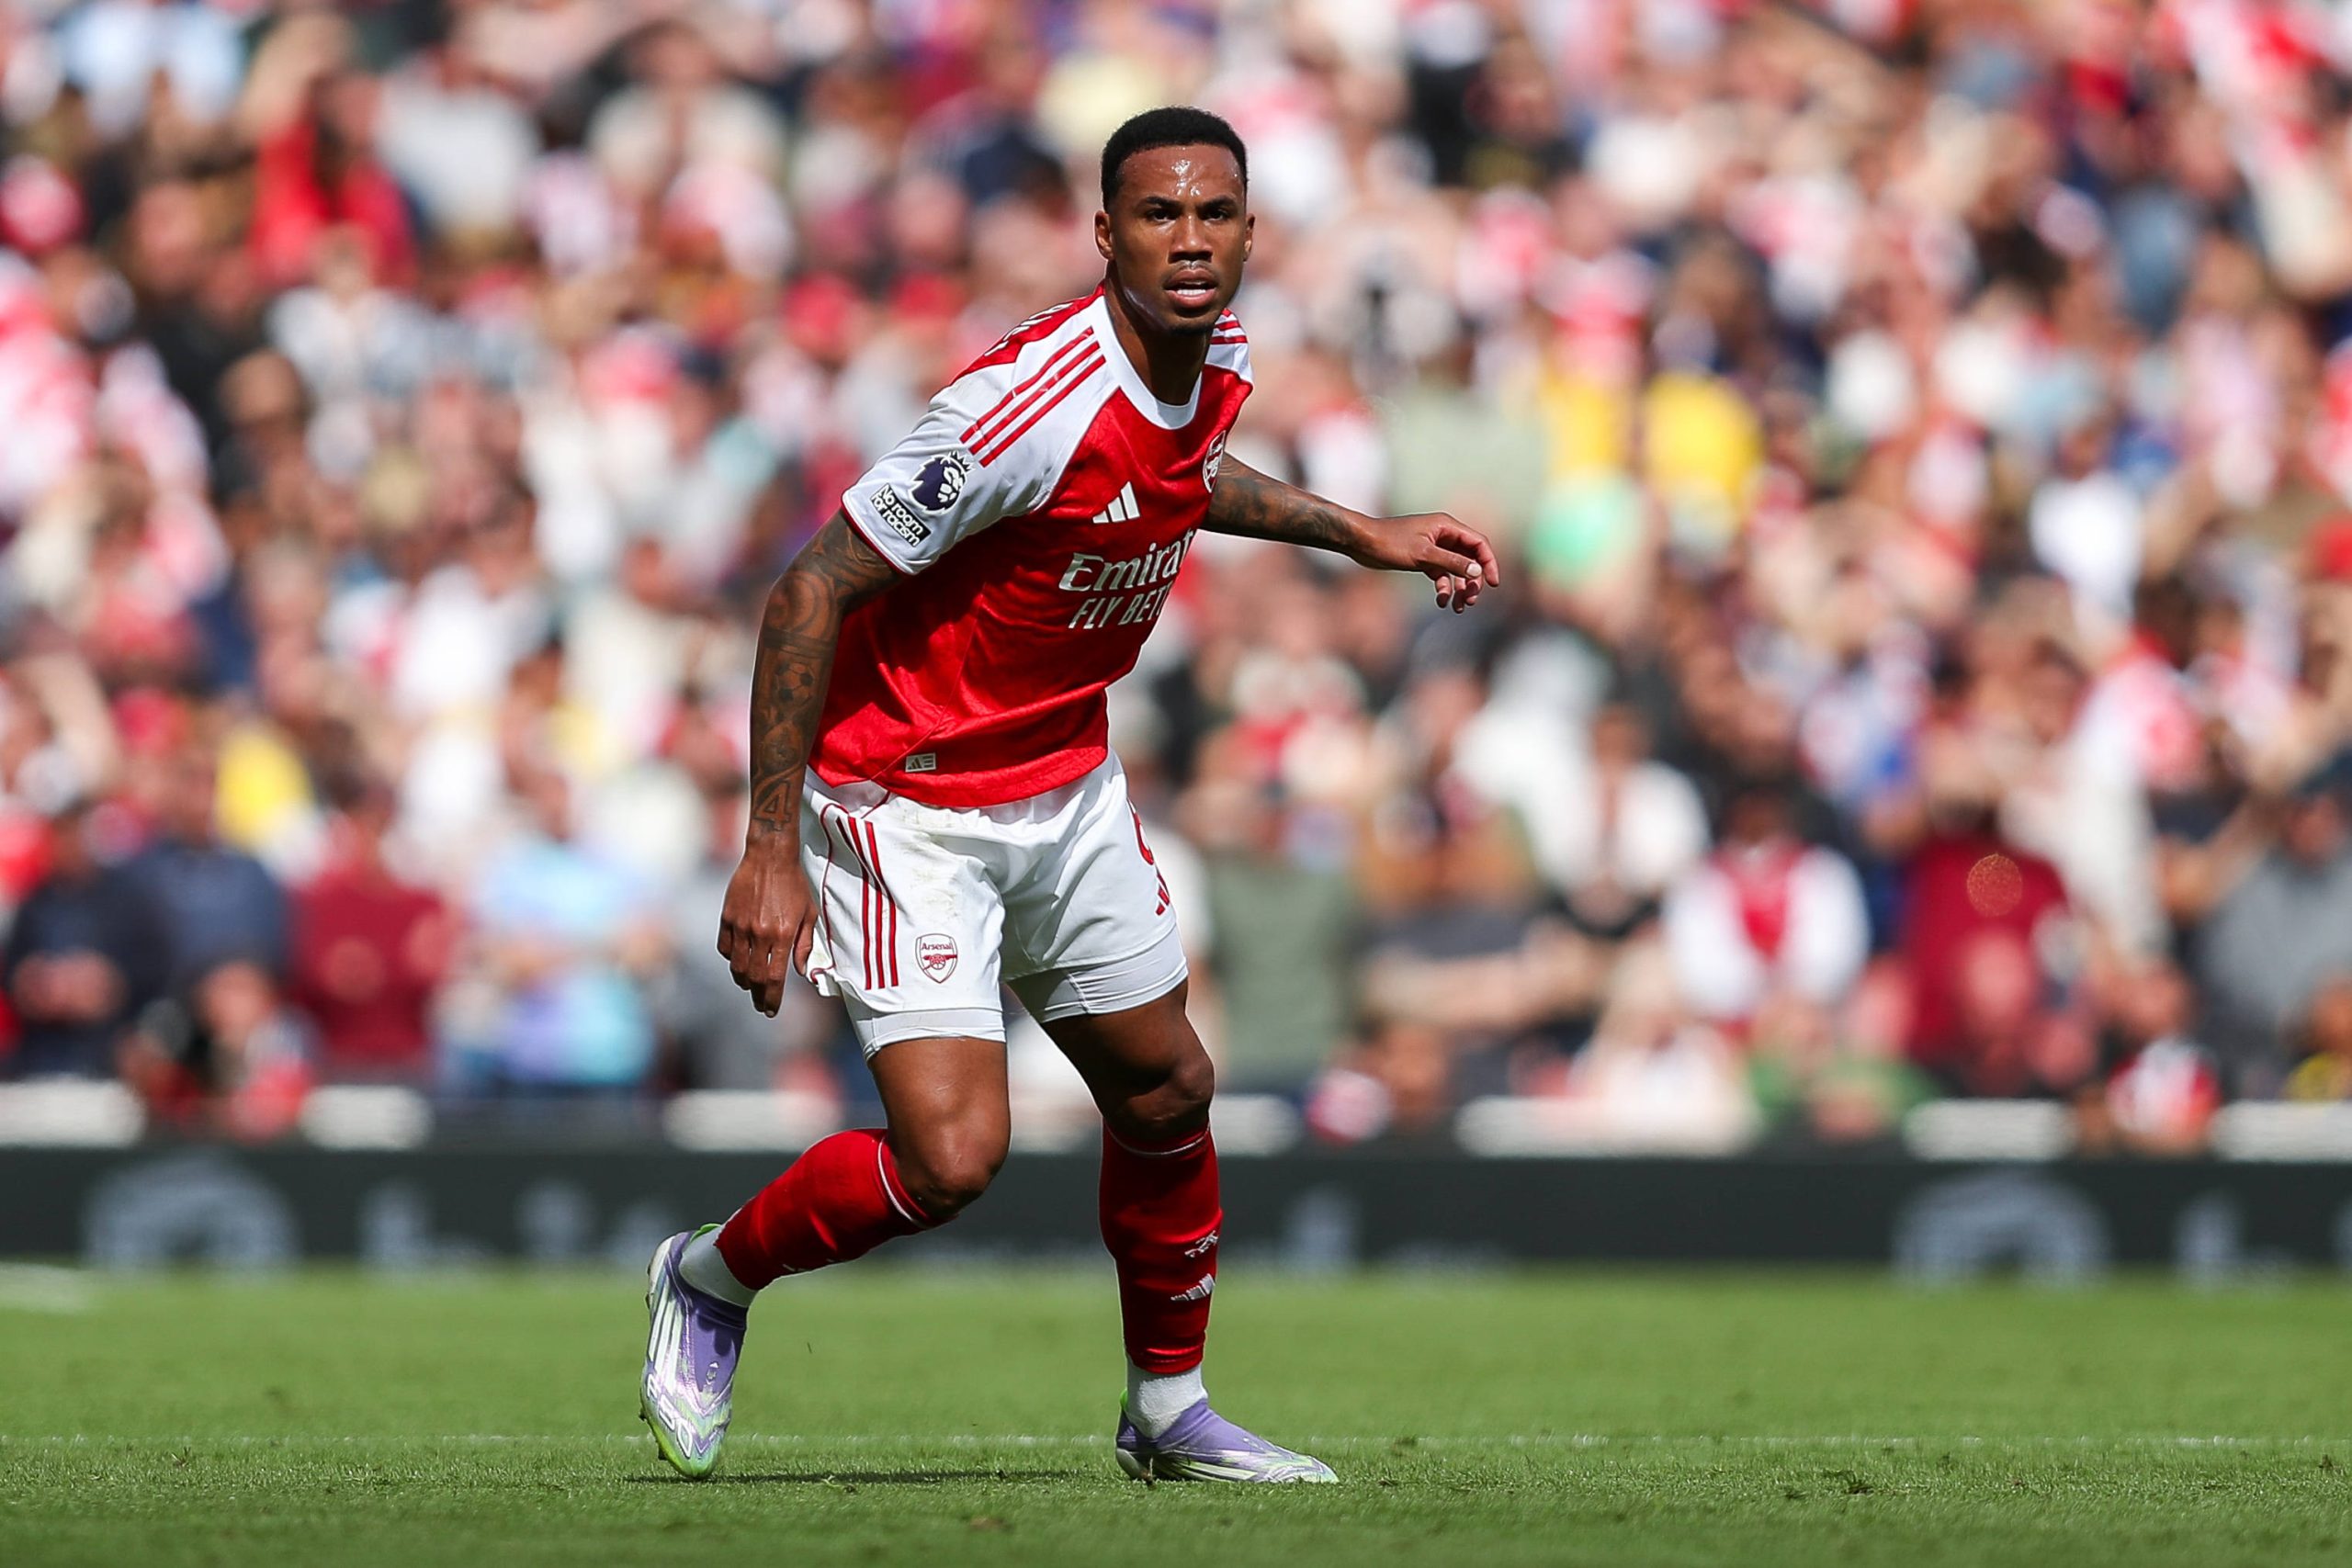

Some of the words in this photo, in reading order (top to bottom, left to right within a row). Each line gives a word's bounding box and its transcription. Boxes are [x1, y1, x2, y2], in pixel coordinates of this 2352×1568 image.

[871, 491, 888, 511] for
[882, 510, 920, 547] racism
[879, 484, 895, 505] No
[891, 503, 923, 535] room
[1068, 596, 1124, 629] FLY
